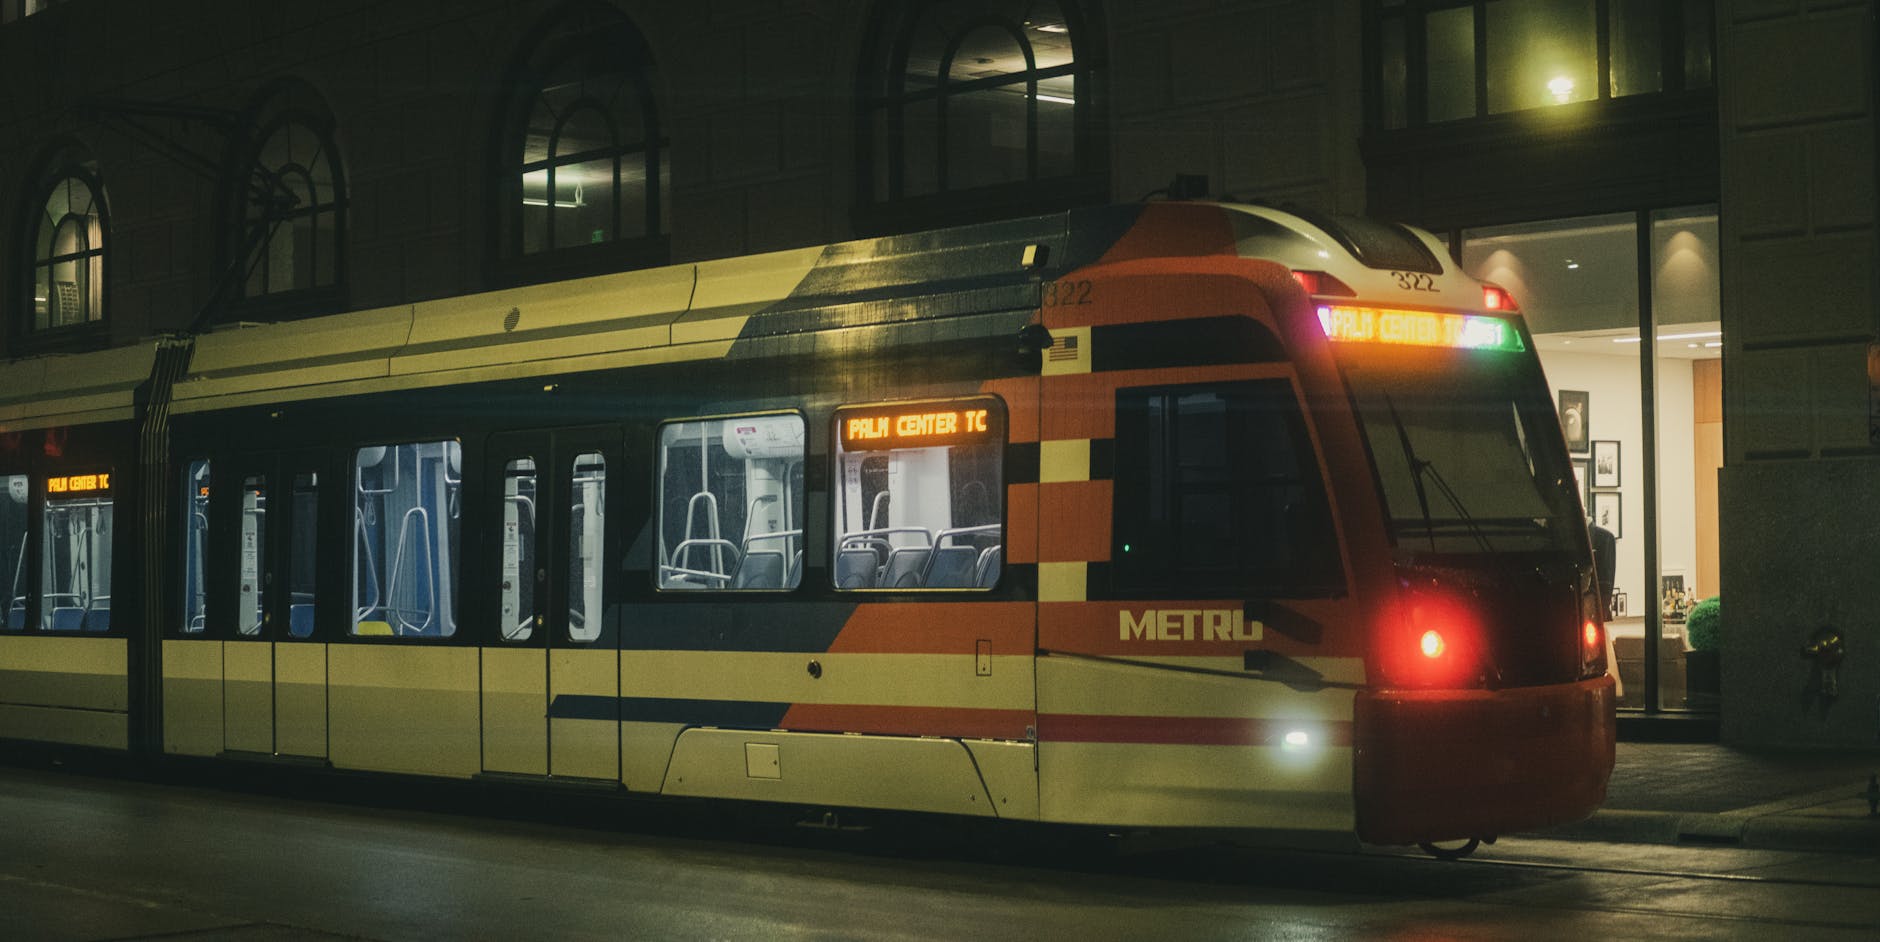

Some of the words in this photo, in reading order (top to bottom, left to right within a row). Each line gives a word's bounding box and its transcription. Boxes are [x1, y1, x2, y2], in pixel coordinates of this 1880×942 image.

[1043, 280, 1092, 307] 322
[1391, 271, 1440, 292] 322
[1331, 308, 1374, 340] PALM
[1379, 312, 1438, 343] CENTER
[847, 417, 889, 440] PALM
[896, 412, 958, 437] CENTER
[965, 409, 988, 433] TC
[48, 477, 67, 493] PALM
[69, 474, 97, 491] CENTER
[98, 473, 109, 489] TC
